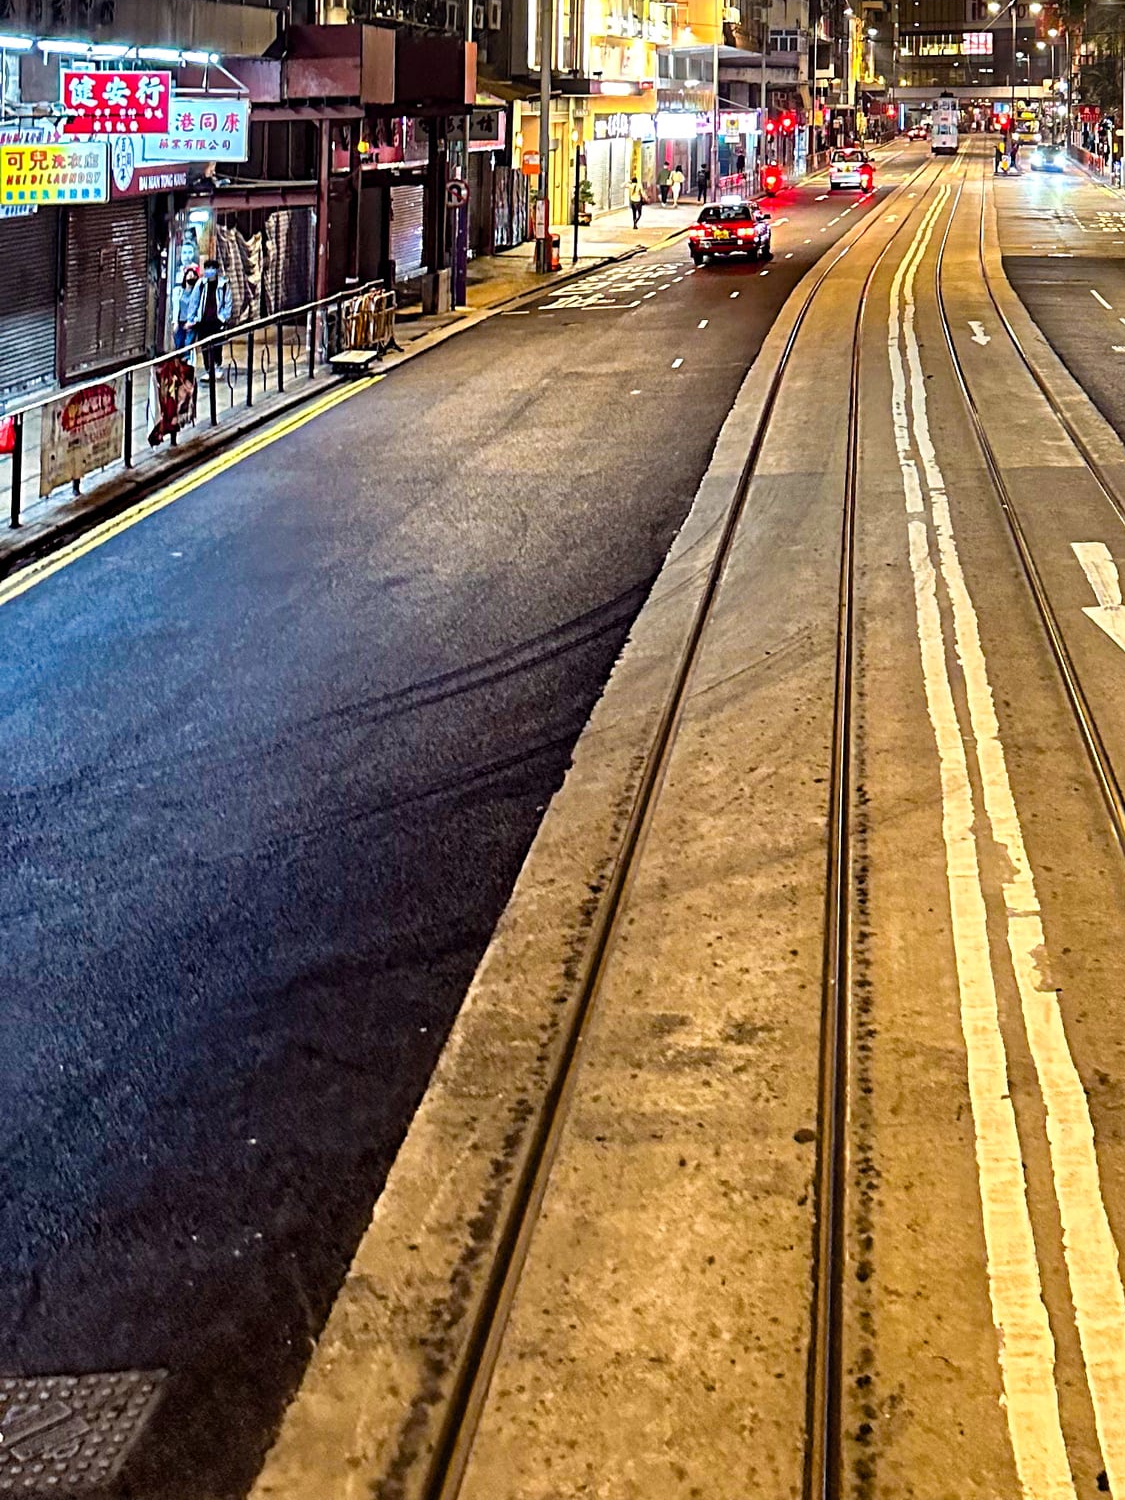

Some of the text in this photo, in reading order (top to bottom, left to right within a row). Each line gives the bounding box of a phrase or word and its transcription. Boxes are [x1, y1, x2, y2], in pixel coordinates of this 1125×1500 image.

[68, 75, 165, 109] 健安行
[175, 112, 241, 134] 港同康
